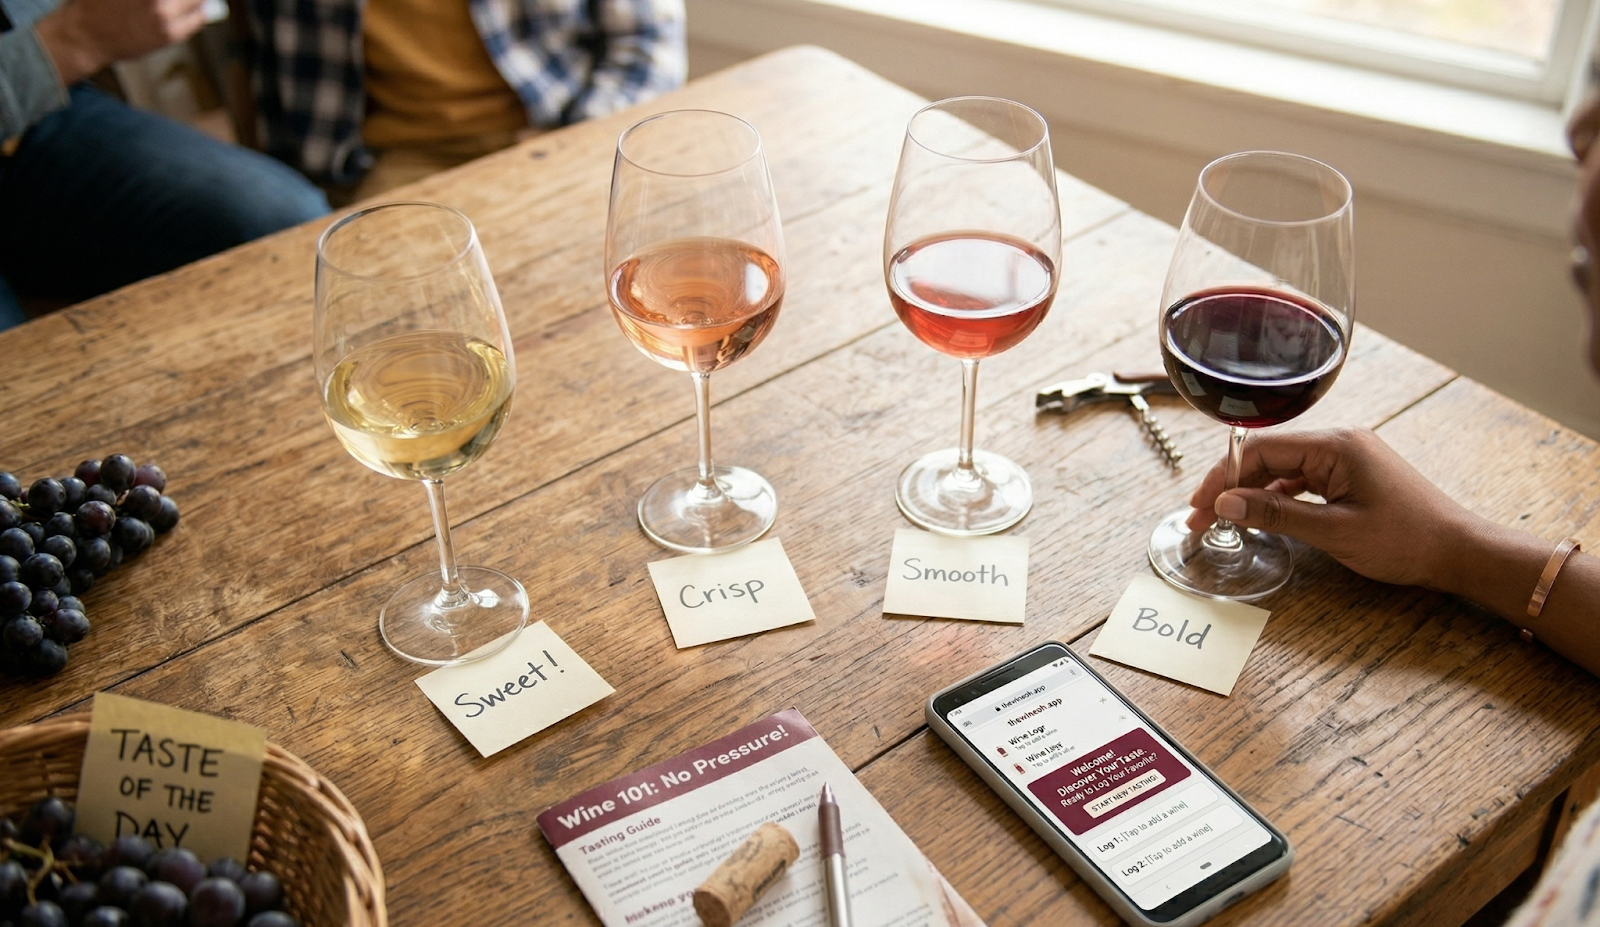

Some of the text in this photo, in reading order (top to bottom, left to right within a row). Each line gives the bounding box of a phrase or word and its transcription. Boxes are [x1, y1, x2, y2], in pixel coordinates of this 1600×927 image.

[902, 557, 1009, 587] Smooth
[679, 578, 765, 609] Crisp
[1131, 607, 1212, 650] Bold
[454, 649, 565, 718] Sweet!
[1007, 697, 1063, 727] thewineoh.app
[111, 729, 225, 777] TASTE
[1070, 749, 1117, 777] Welcome!
[120, 776, 216, 813] OF THE
[557, 724, 789, 830] Wine 101: No Pressure!
[1056, 772, 1098, 797] Discover
[1095, 761, 1119, 776] Your
[1060, 752, 1158, 807] Ready to Log Your Favorite?
[1091, 796, 1115, 813] START
[1112, 789, 1129, 801] NEW
[115, 811, 190, 850] DAY
[579, 817, 662, 855] Tasting Guide
[1096, 840, 1116, 853] Log
[1113, 836, 1123, 844] 1:
[1138, 823, 1148, 832] to
[1148, 814, 1163, 827] add
[1121, 863, 1140, 877] Log
[1137, 860, 1148, 868] 2:
[1162, 846, 1173, 855] to
[1172, 837, 1187, 850] add
